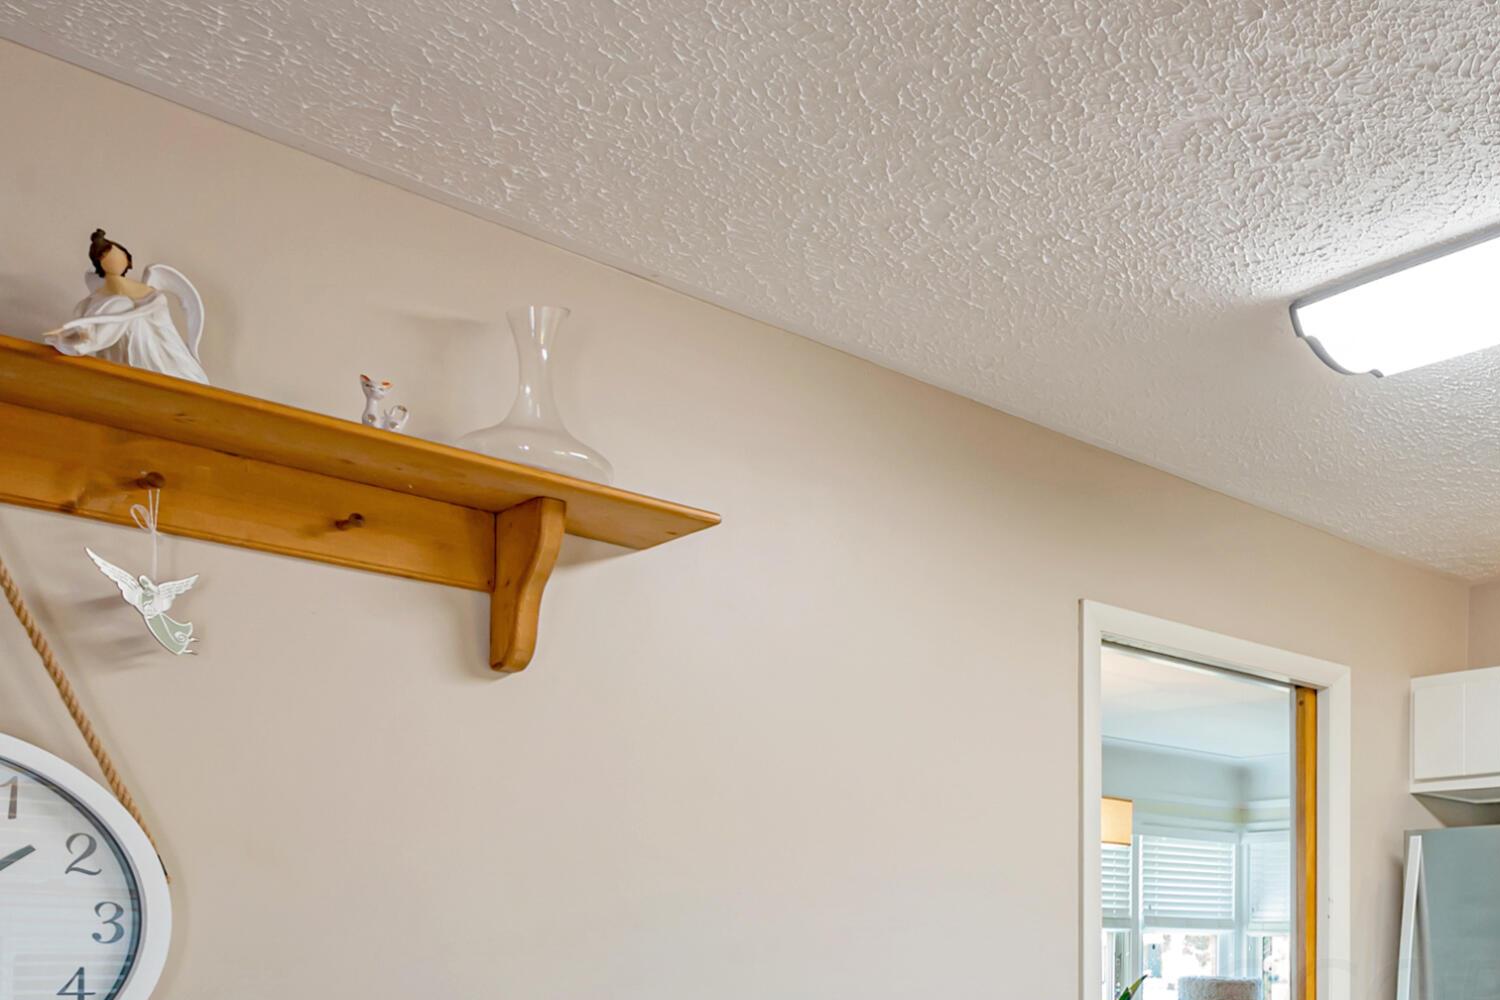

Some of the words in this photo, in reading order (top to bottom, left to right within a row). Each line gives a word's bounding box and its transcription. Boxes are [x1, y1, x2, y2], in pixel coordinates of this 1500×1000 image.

[0, 776, 17, 819] 1
[65, 833, 102, 876] 2
[92, 902, 125, 944] 3
